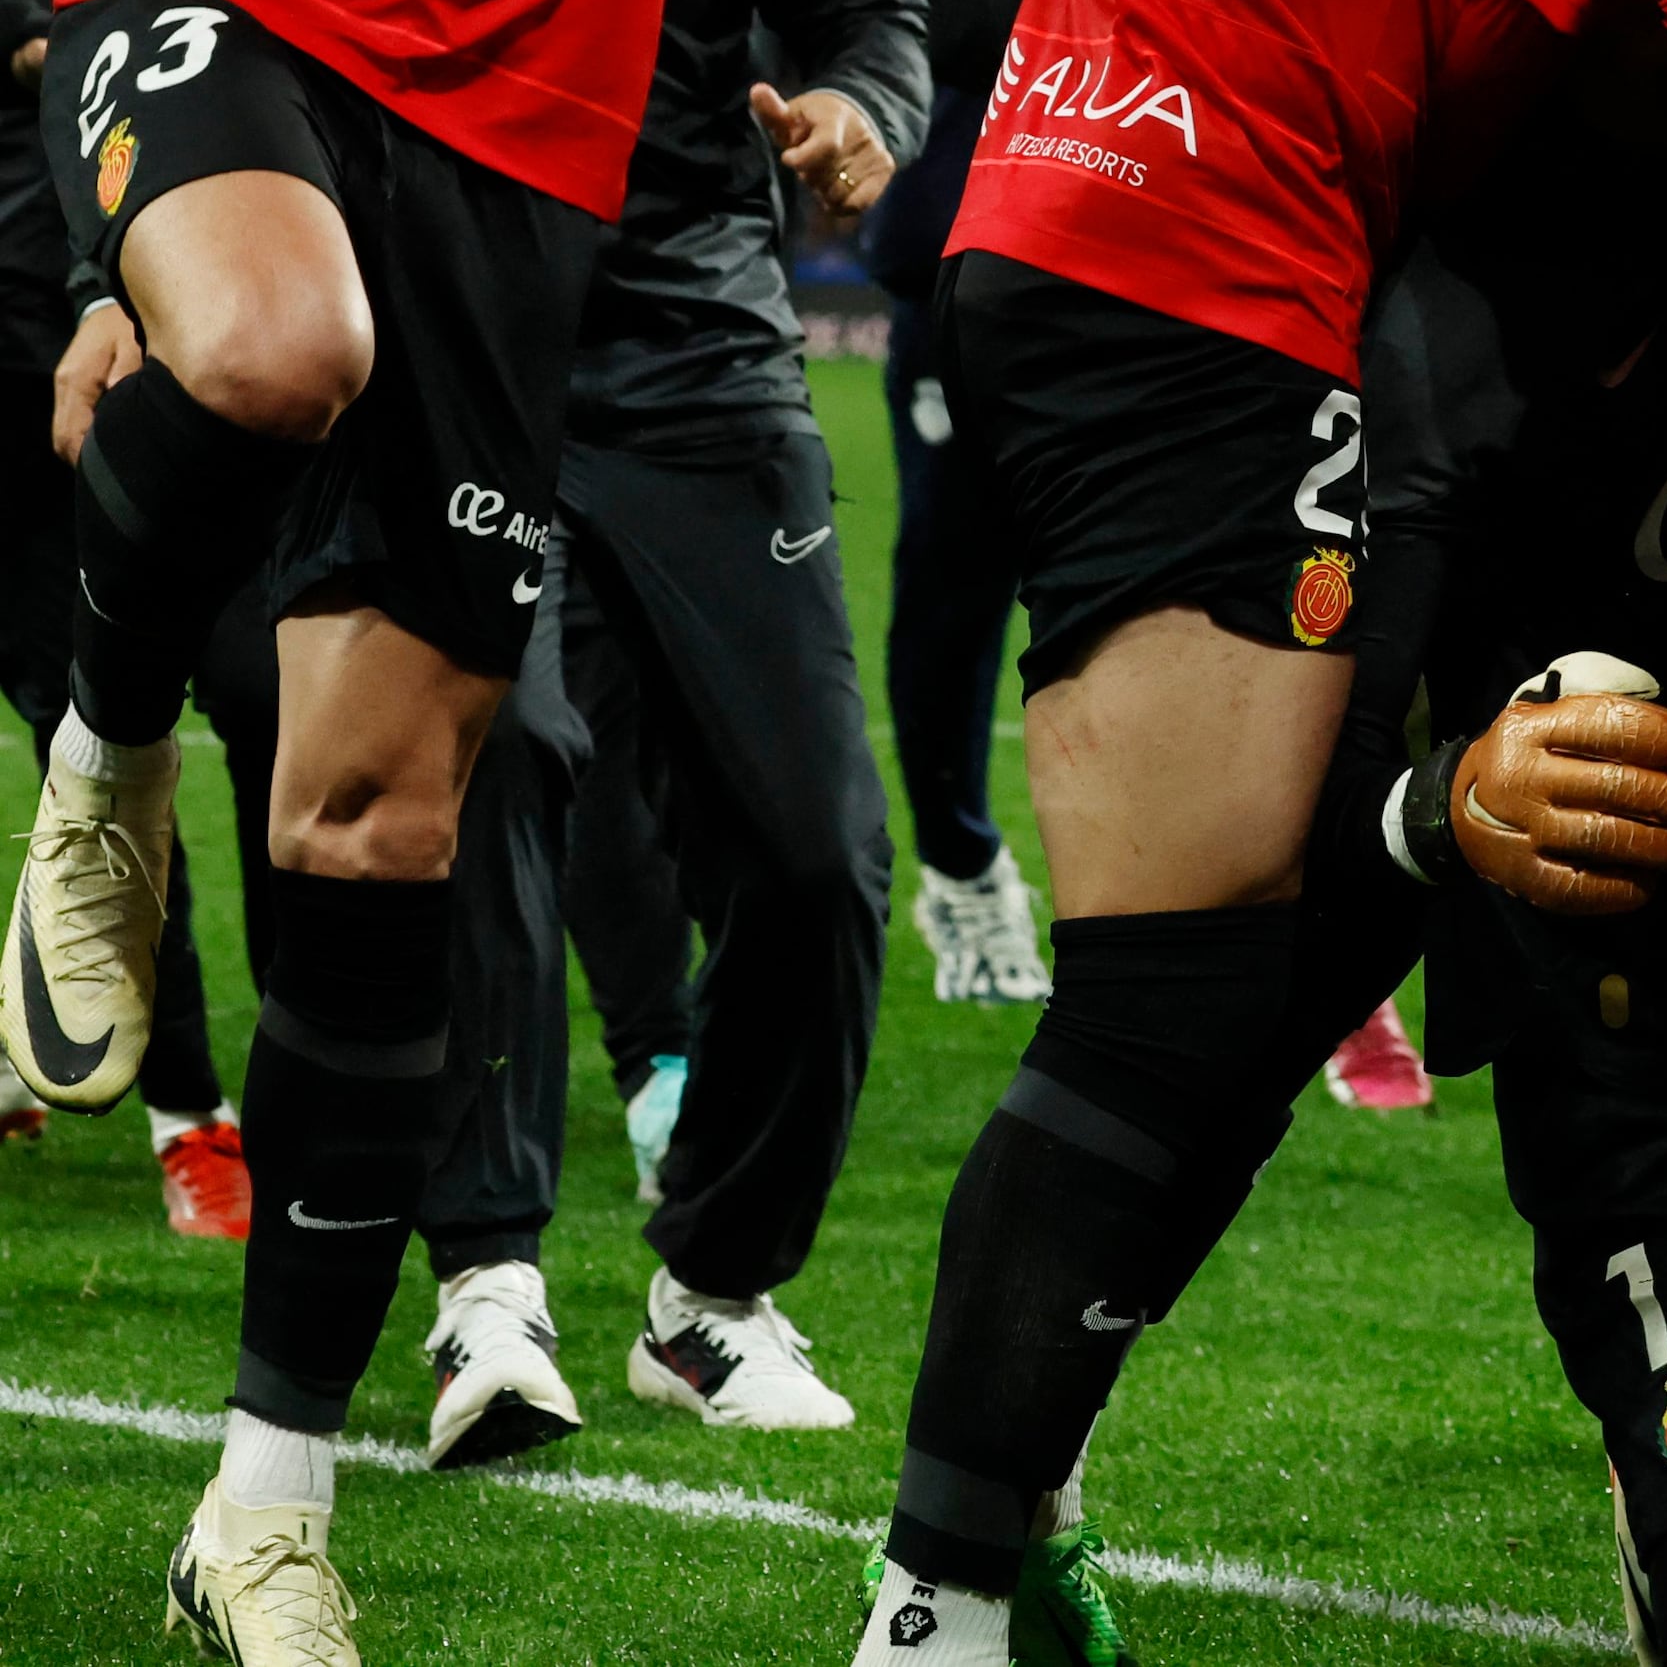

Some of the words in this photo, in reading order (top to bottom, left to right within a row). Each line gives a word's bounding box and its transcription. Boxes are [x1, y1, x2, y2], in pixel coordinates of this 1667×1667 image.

[77, 6, 231, 160] 23
[1016, 56, 1198, 158] ALUA
[1052, 138, 1148, 187] RESORTS
